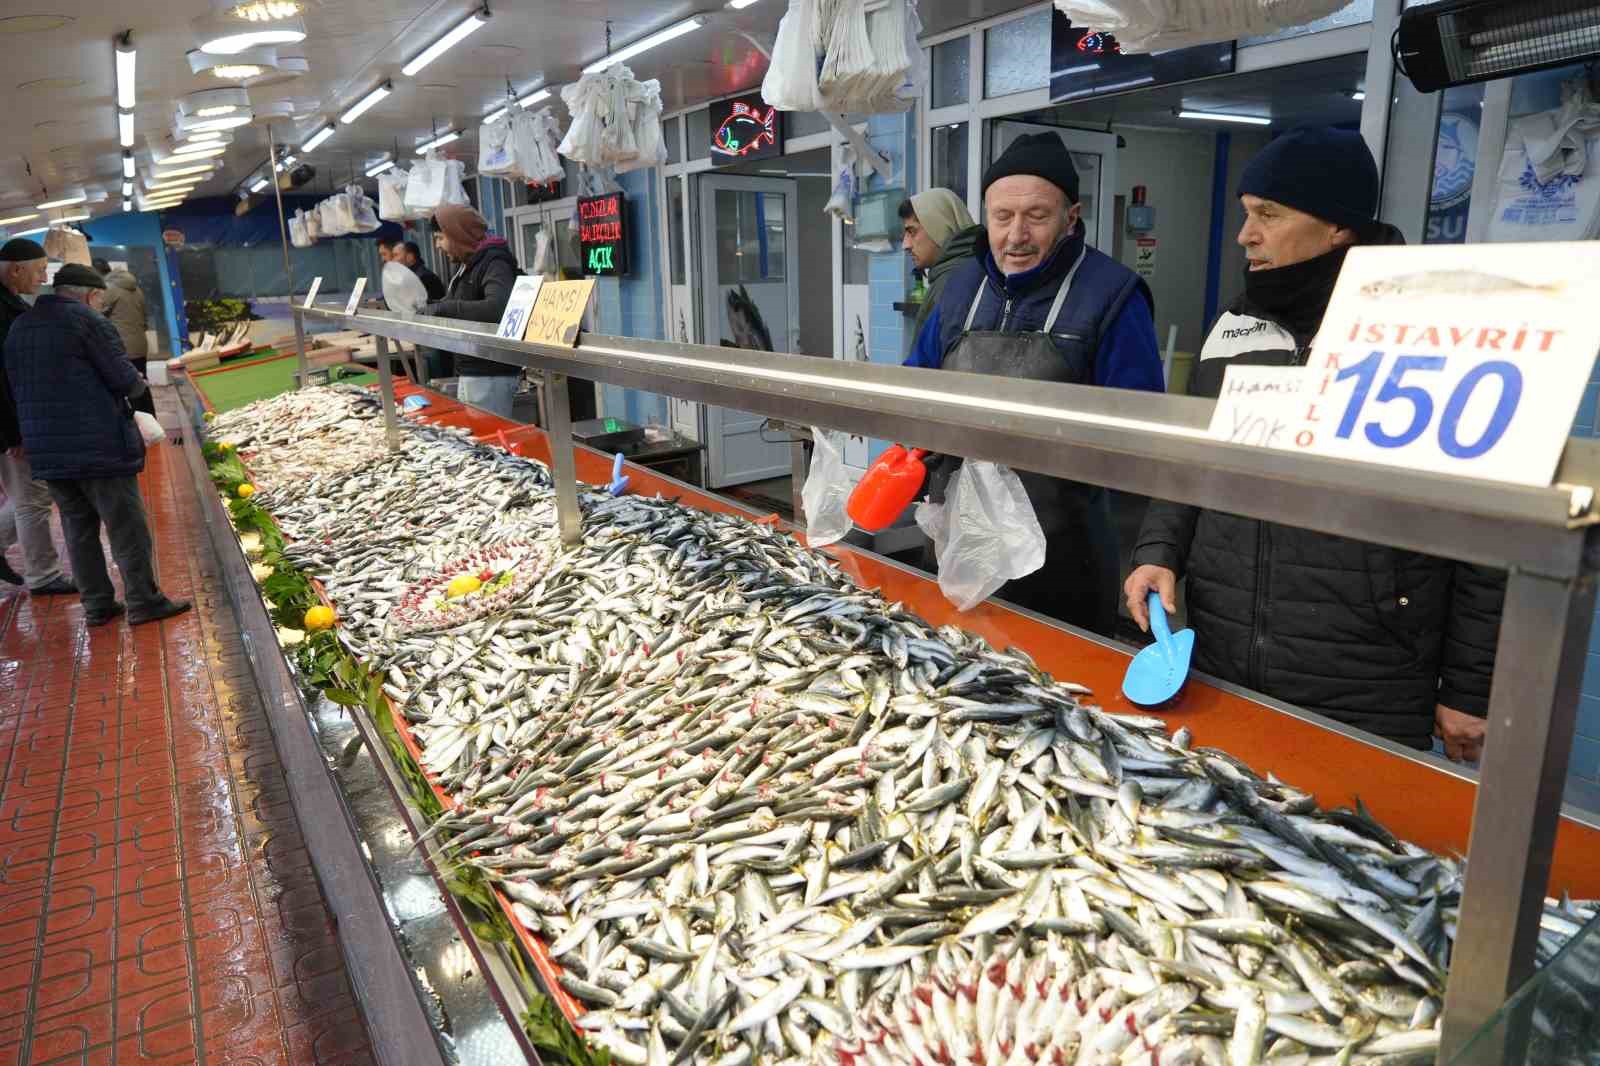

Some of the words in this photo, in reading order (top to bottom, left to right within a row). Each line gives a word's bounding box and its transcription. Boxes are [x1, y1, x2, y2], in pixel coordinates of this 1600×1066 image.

[589, 247, 614, 273] AÇIK
[502, 307, 525, 337] 150
[538, 312, 567, 342] YOK
[1221, 321, 1267, 339] macron
[1348, 316, 1565, 351] İSTAVRİT
[1335, 350, 1523, 459] 150
